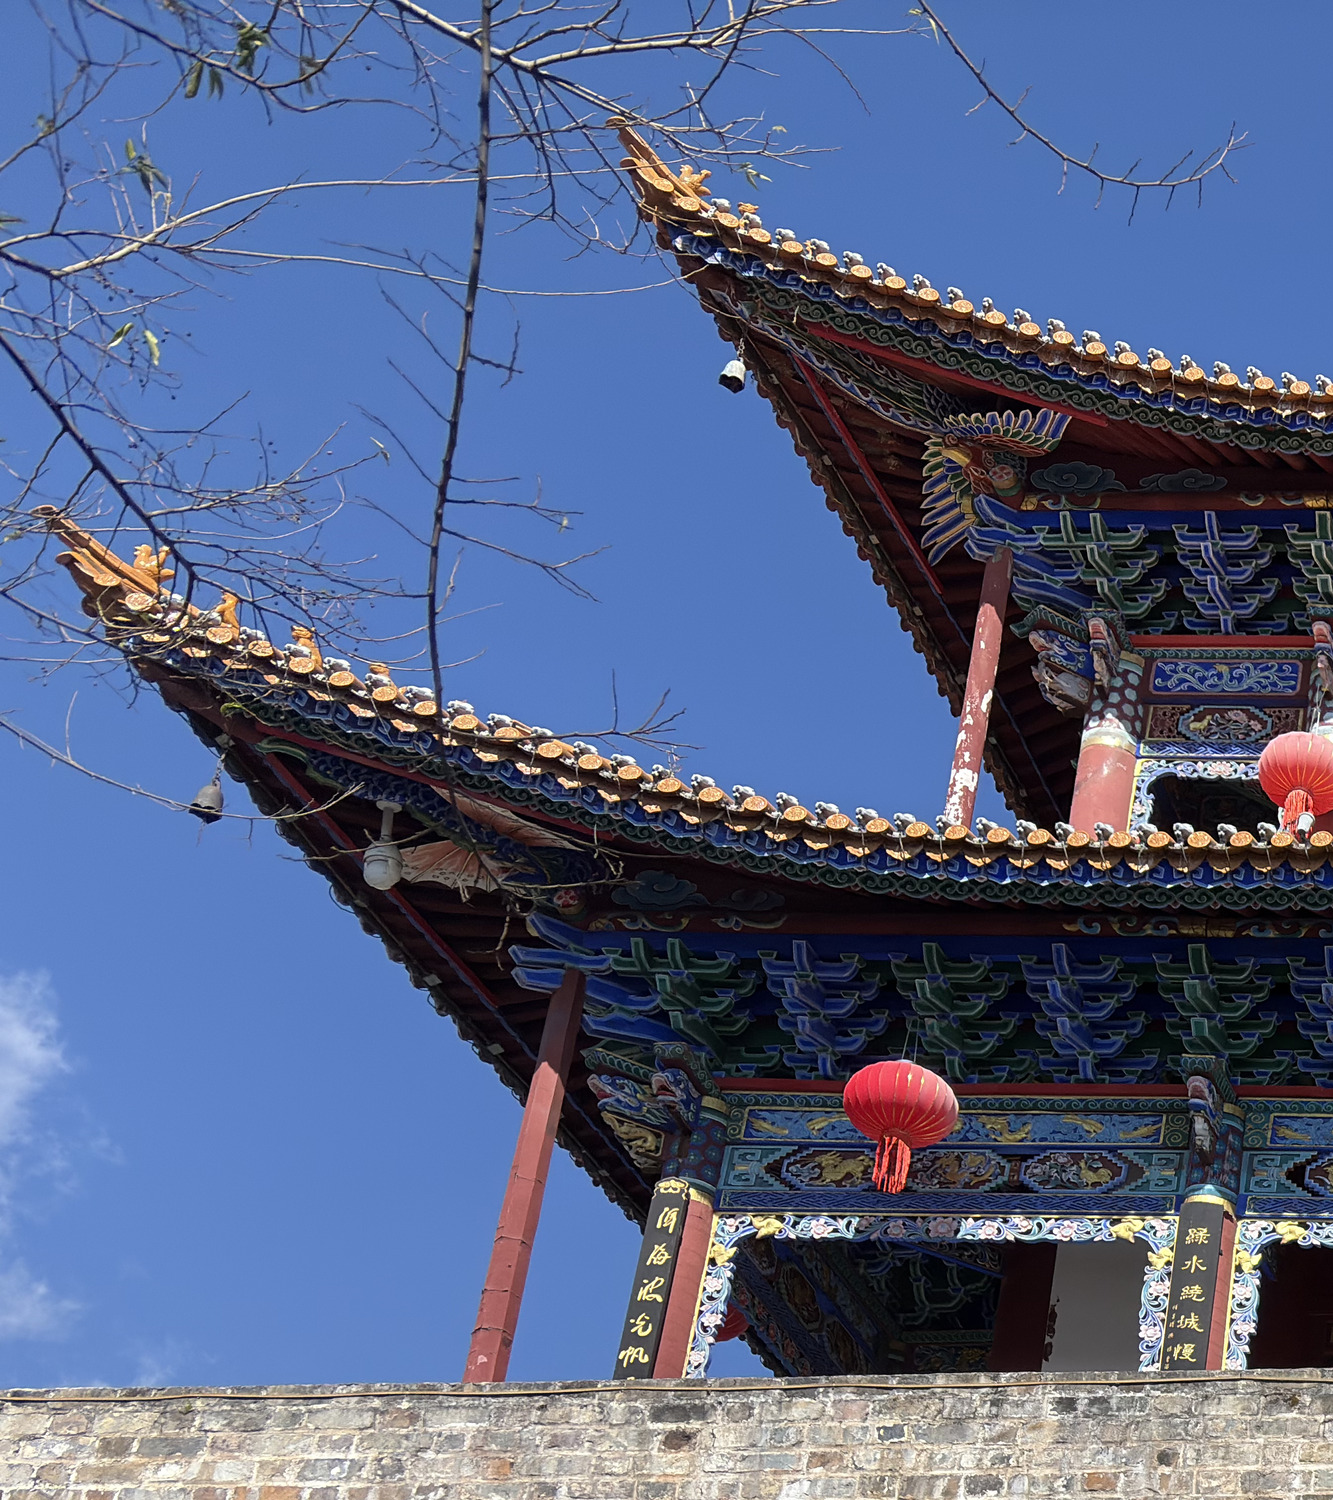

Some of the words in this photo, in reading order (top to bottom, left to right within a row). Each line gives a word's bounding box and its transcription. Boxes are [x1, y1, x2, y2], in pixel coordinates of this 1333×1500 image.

[618, 1205, 680, 1380] 洱海波光帆
